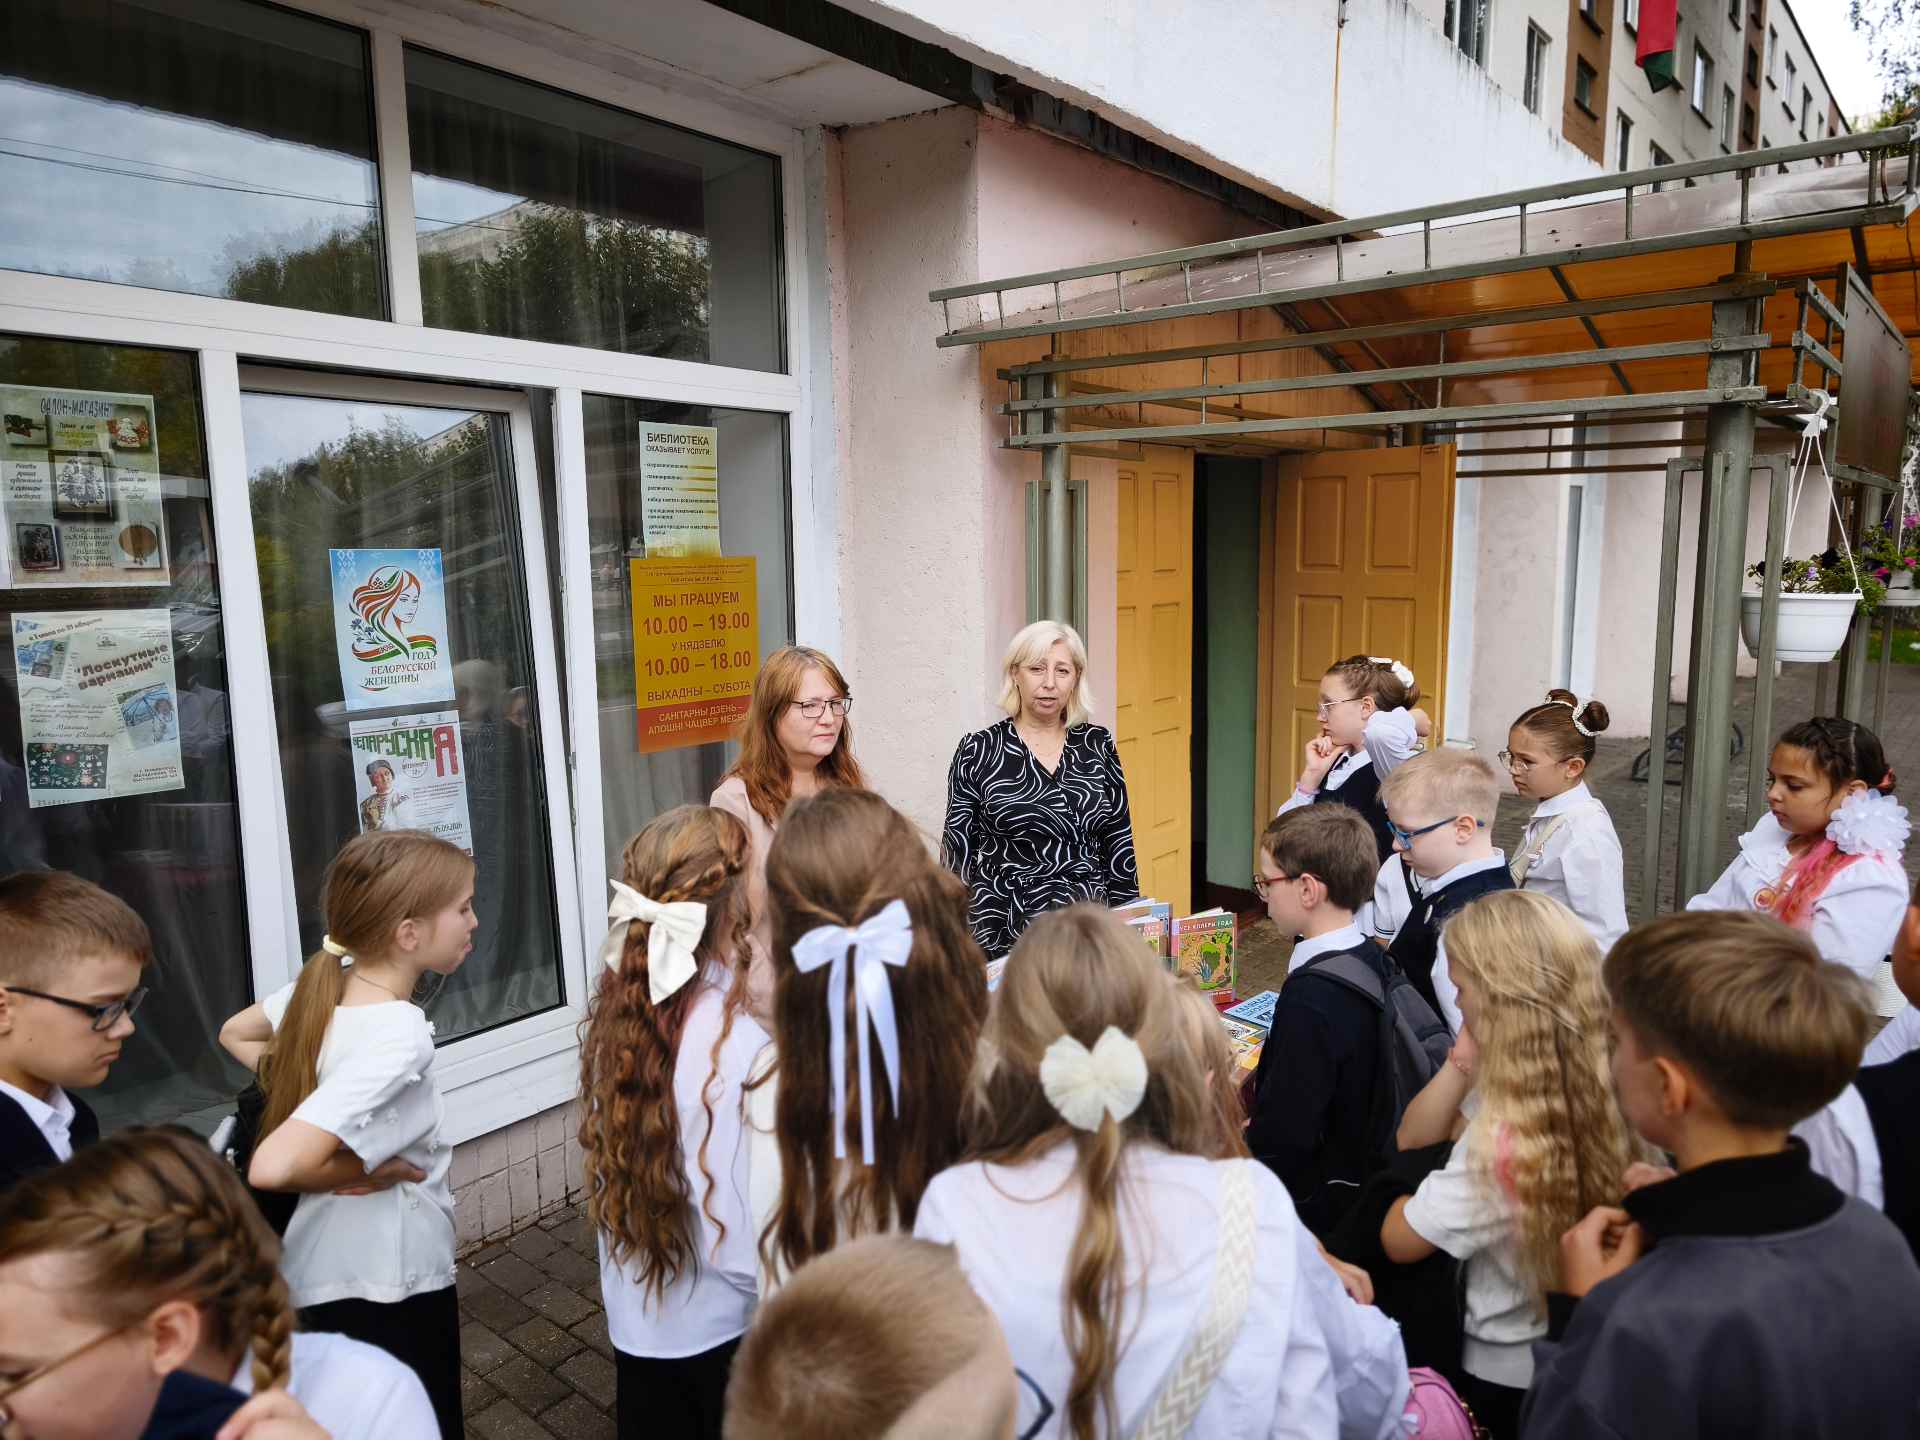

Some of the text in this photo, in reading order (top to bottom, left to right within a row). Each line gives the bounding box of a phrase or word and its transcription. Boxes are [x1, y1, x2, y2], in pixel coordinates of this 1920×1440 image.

[647, 433, 709, 446] БИБЛИОТЕКА
[646, 446, 686, 454] ОКАЗЫВАЕТ
[653, 591, 740, 609] МЫ ПРАЦУЕМ
[643, 615, 688, 635] 10.00
[709, 612, 750, 631] 19.00
[672, 638, 726, 652] У НЯДЗЕЛЮ
[412, 651, 430, 661] ГОД
[645, 656, 690, 676] 10.00
[710, 650, 752, 670] 18.00
[371, 660, 437, 675] БЕЛОРУССКОЙ
[363, 674, 419, 687] ЖЕНЩИНЫ
[647, 686, 703, 702] ВЫХАДНЫ
[713, 680, 752, 694] СУБОТА
[659, 707, 708, 722] САНІТАРНЫ
[709, 703, 736, 715] ДЗЕНЬ
[648, 722, 683, 737] АПОШНІ
